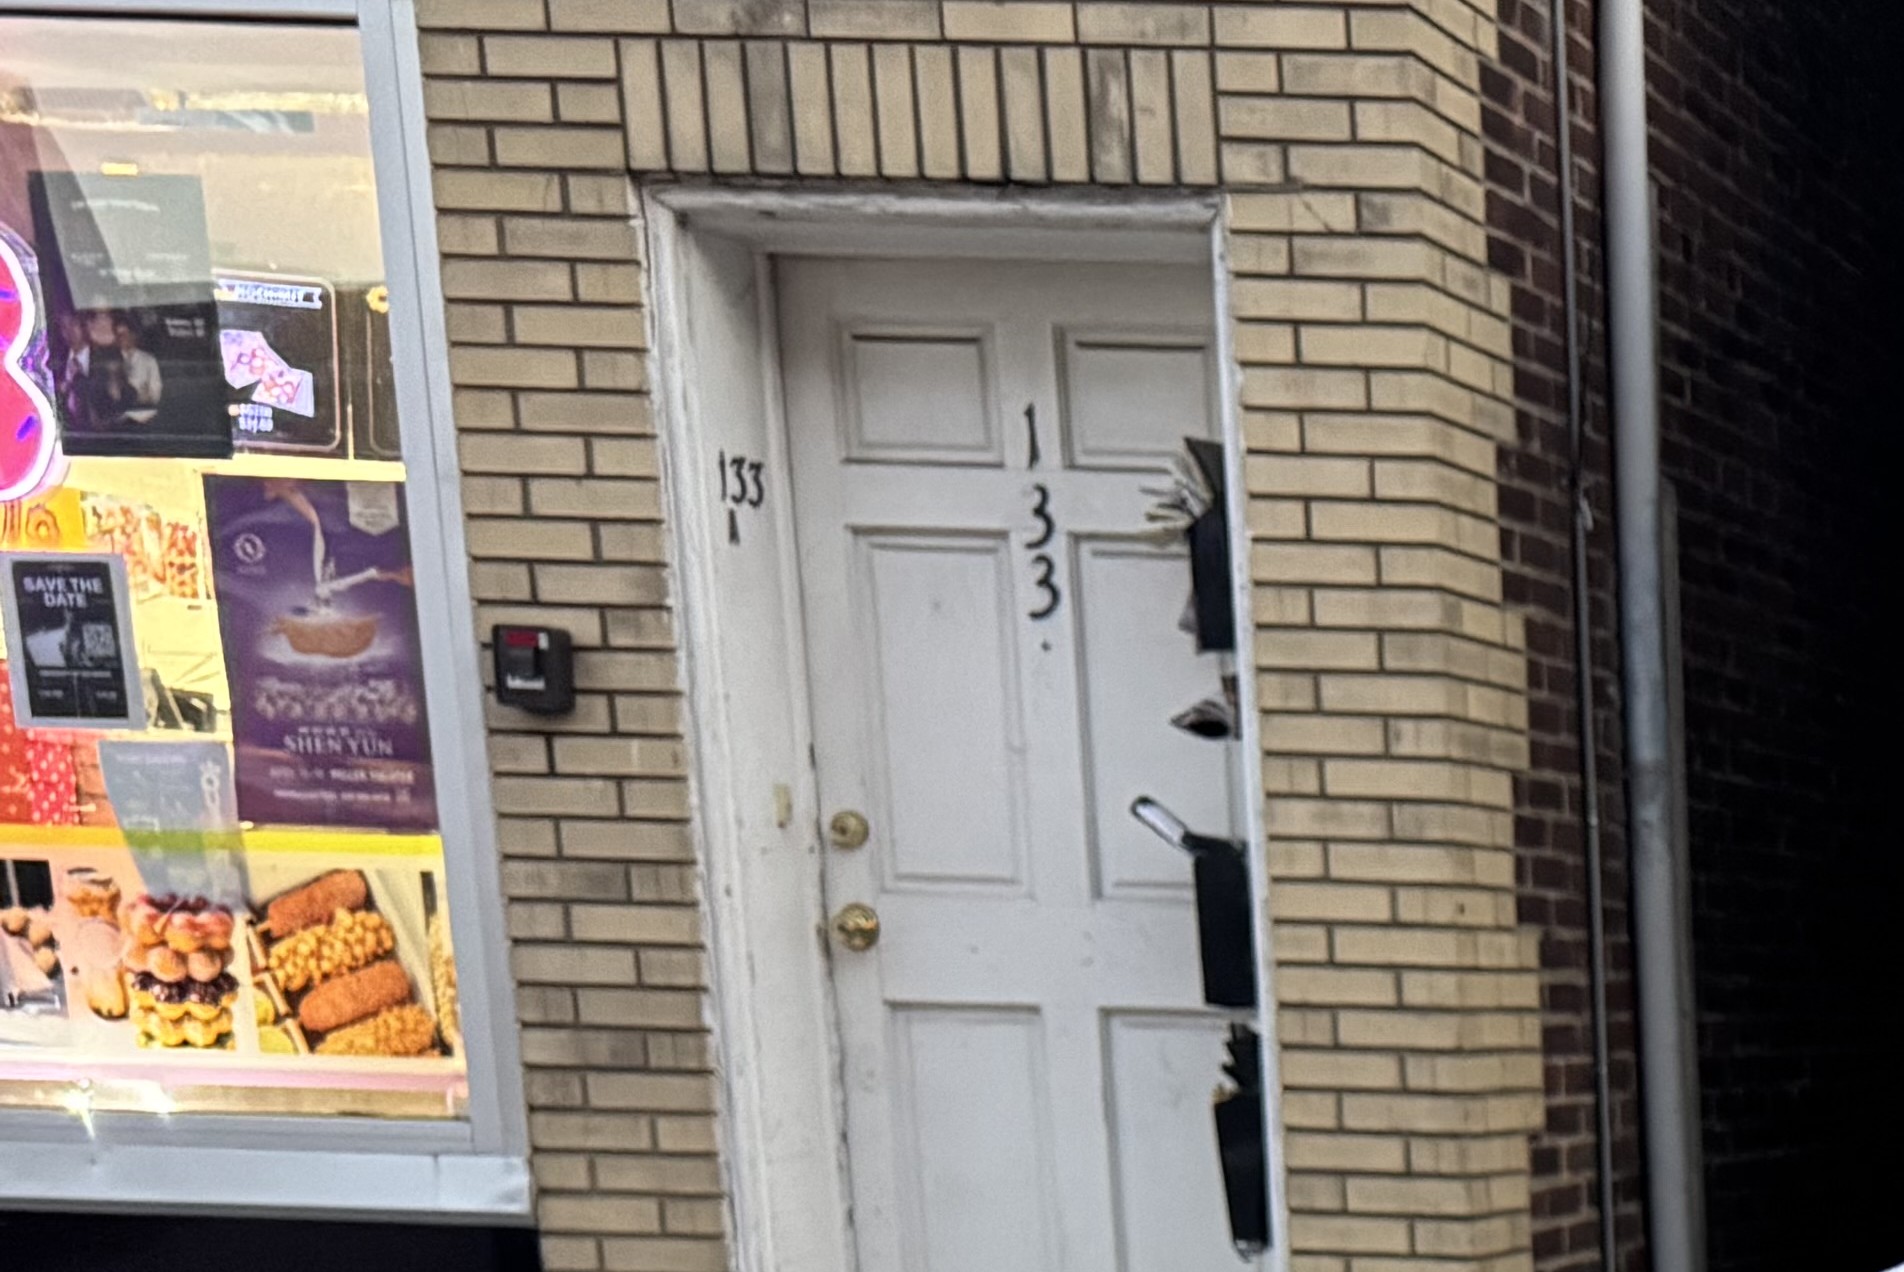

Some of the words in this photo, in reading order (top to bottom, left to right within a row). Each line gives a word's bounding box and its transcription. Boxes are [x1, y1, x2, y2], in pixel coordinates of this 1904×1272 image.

[719, 449, 765, 508] 133
[1024, 403, 1061, 621] 133
[23, 577, 65, 593] SAVE
[69, 577, 102, 594] THE
[44, 593, 86, 608] DATE
[284, 733, 344, 756] SHEN
[347, 735, 393, 756] YUN
